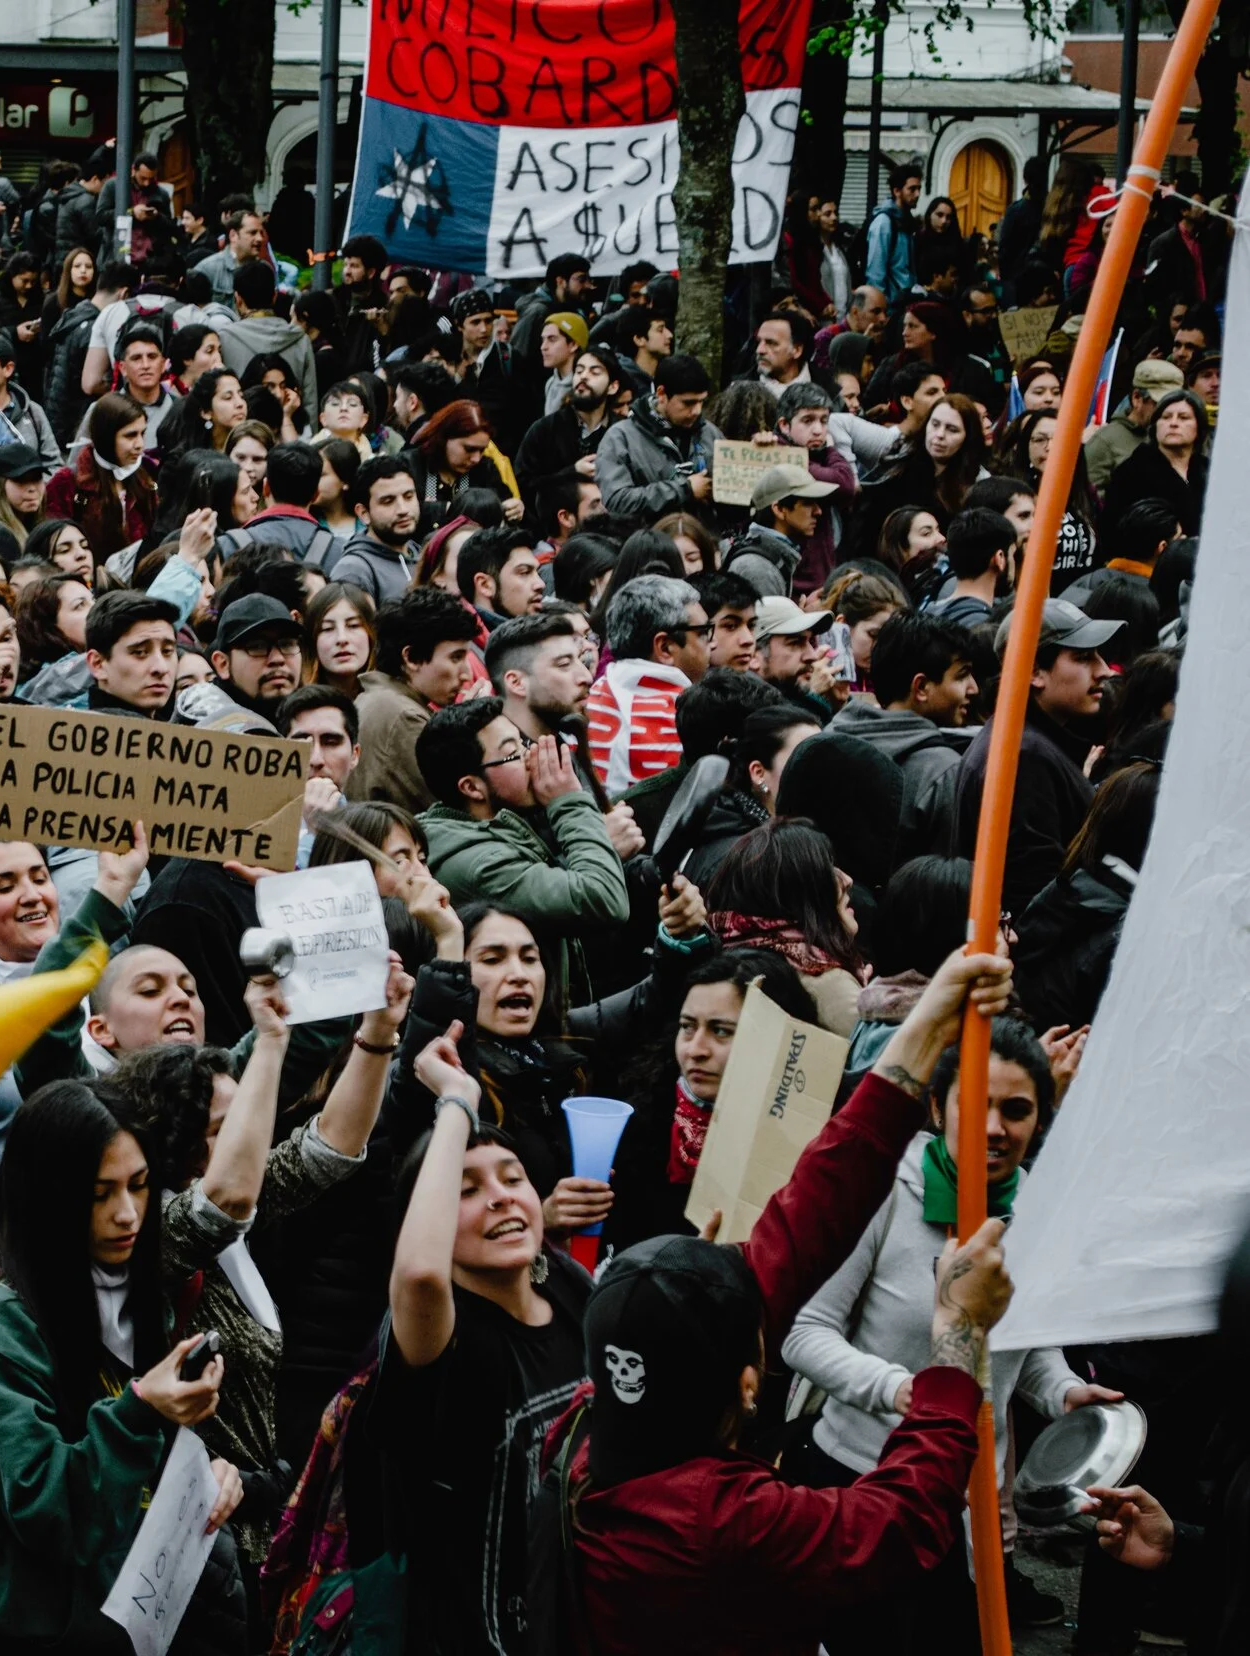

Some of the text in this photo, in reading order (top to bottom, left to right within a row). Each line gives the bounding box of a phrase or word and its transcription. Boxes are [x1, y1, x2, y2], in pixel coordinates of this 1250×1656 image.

[386, 36, 789, 124] COBARDS
[505, 100, 798, 192] ASESIOS
[499, 186, 779, 268] A $UED
[33, 761, 135, 799] POLICIA
[153, 775, 229, 813] MATA
[48, 721, 213, 769] GOBIERNO
[223, 744, 302, 779] ROBA
[23, 806, 136, 849] PRENSA
[151, 822, 272, 860] MIENTE
[769, 1030, 806, 1119] SPALDING
